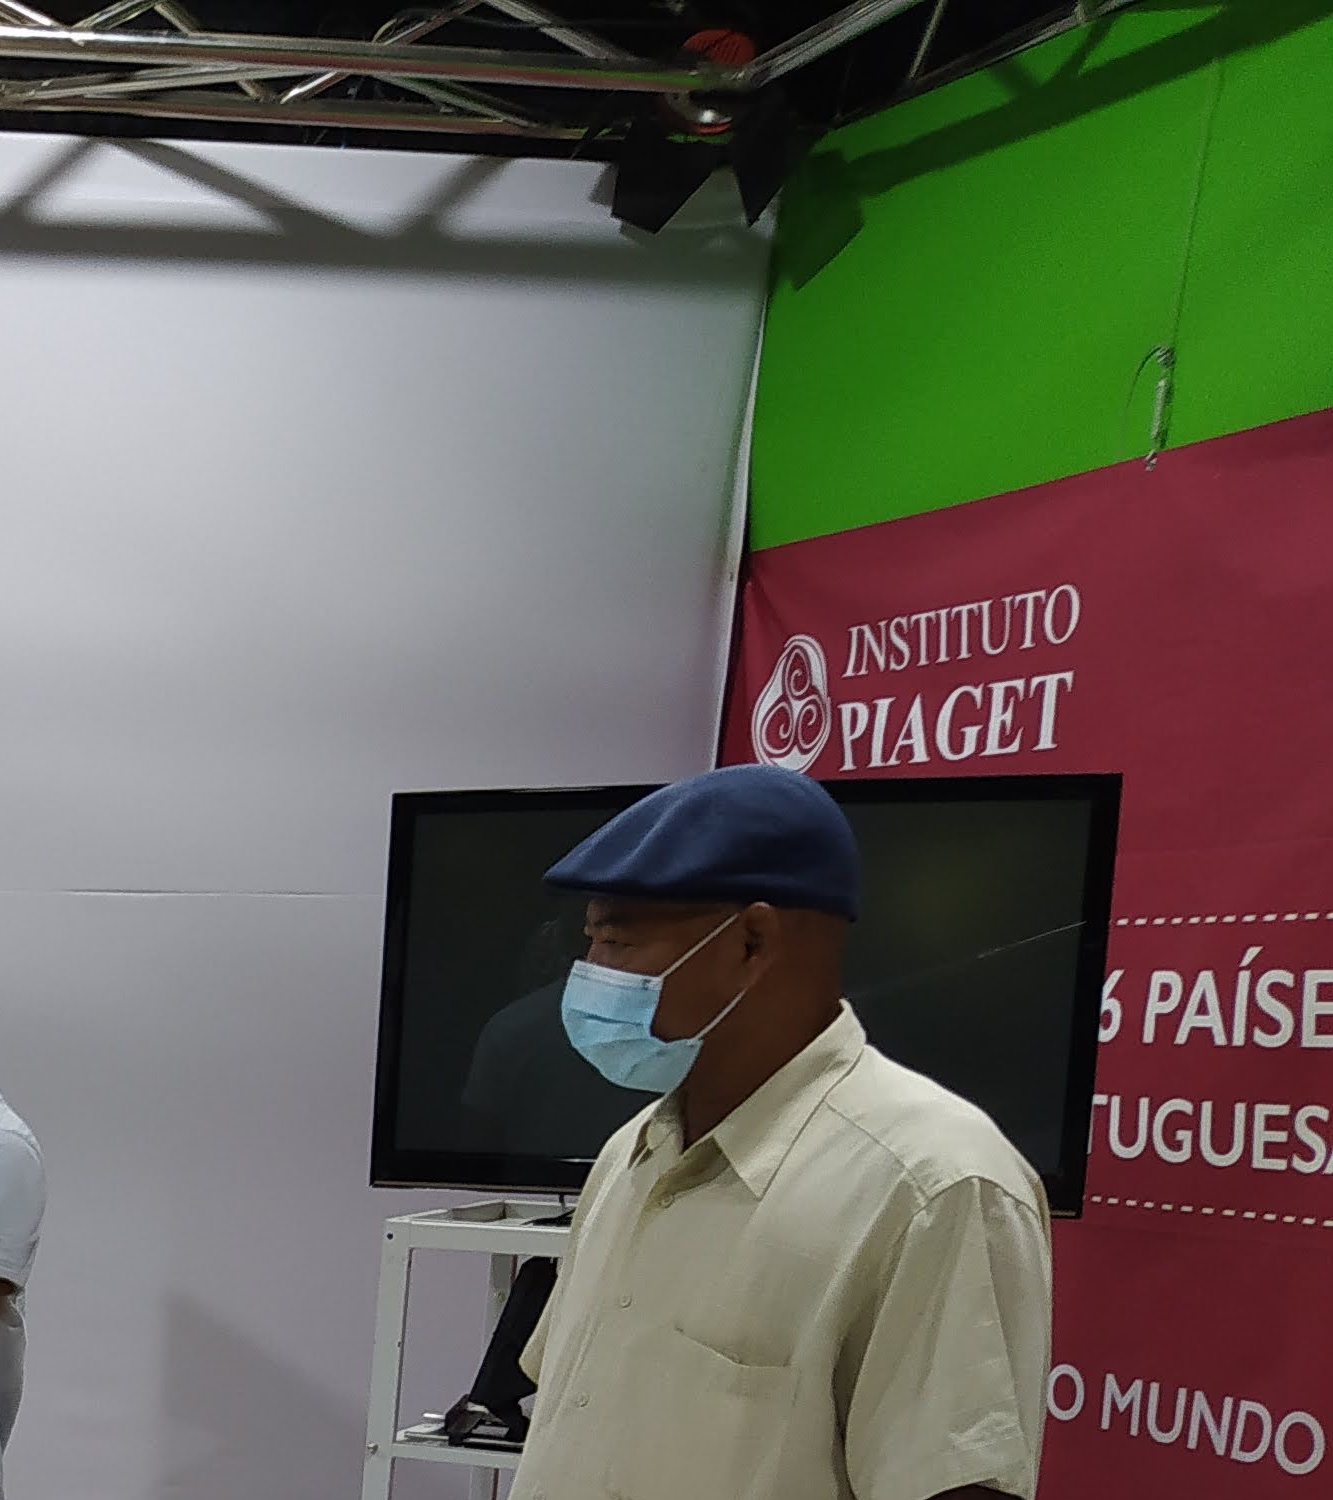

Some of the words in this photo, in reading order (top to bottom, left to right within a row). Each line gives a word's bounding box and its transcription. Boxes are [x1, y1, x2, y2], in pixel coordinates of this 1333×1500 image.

[842, 584, 1081, 678] INSTITUTO
[838, 671, 1074, 771] PIAGET
[1087, 1094, 1333, 1175] UGUES
[1101, 1373, 1325, 1475] MUNDO
